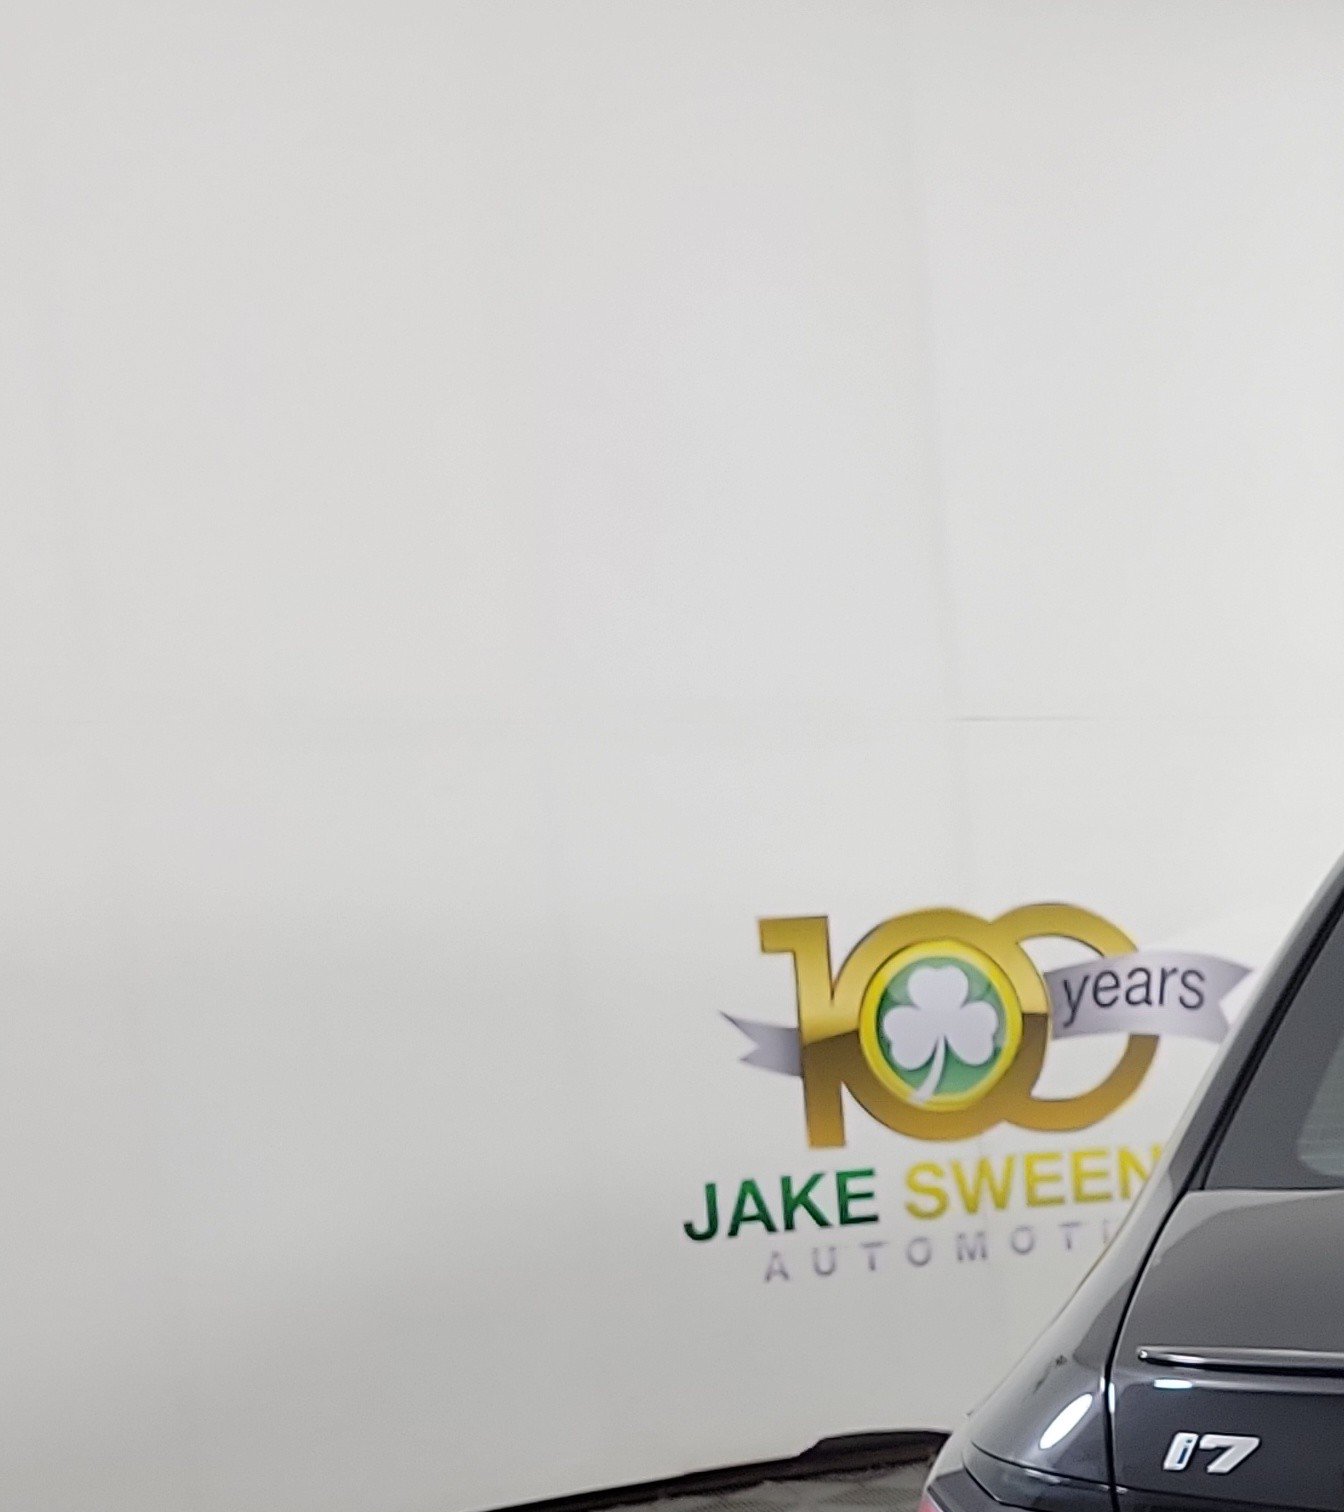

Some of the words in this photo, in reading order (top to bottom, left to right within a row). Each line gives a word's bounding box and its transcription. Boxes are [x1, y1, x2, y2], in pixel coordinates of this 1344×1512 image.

[1060, 965, 1206, 1027] years
[683, 1167, 880, 1242] JAKE
[1163, 1432, 1260, 1473] i7
